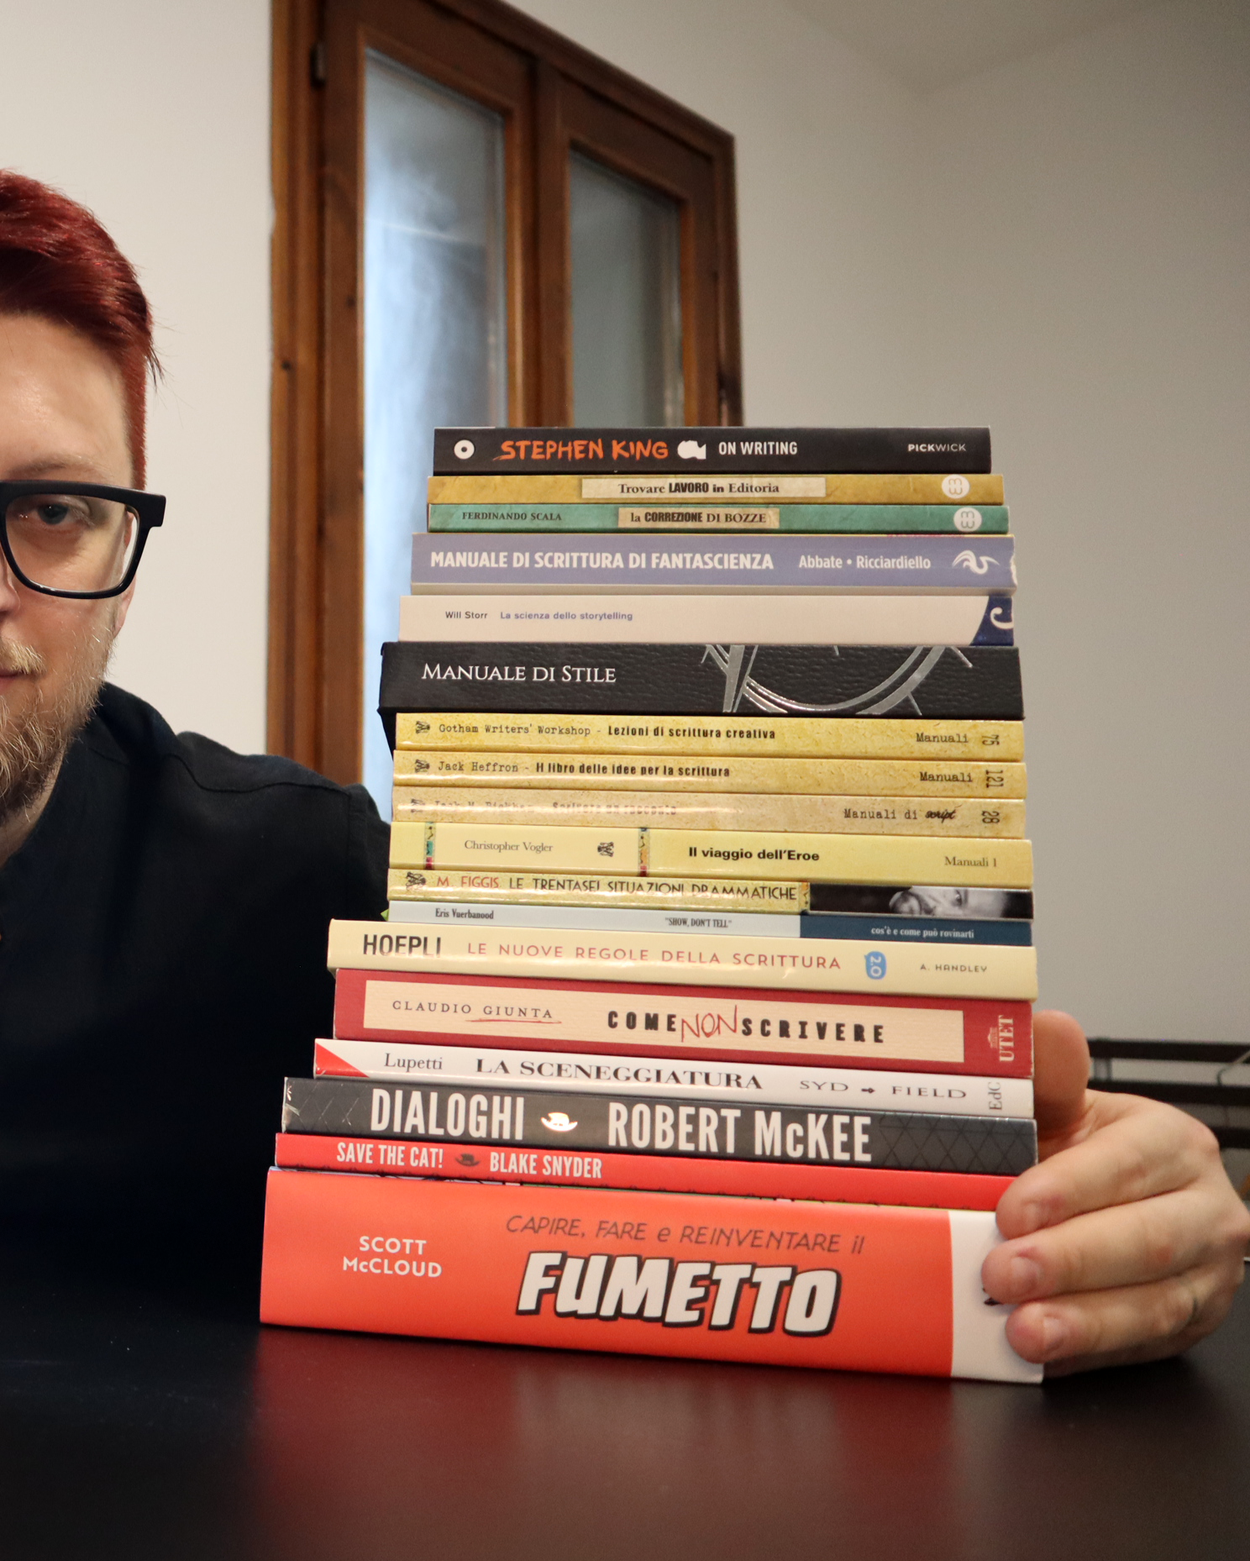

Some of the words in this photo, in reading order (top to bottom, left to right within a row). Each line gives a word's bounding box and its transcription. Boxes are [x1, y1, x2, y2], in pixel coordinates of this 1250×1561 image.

[493, 439, 603, 461] STEPHEN
[612, 439, 669, 460] KING
[719, 442, 738, 455] ON
[740, 442, 798, 455] WRITING
[908, 444, 966, 452] PICKWICK
[618, 484, 665, 494] Trovare
[669, 483, 709, 493] LAVORO
[712, 484, 724, 492] in
[728, 482, 780, 493] Editoria
[462, 512, 527, 520] FERDINANDO
[531, 513, 562, 521] SCALA
[631, 513, 640, 522] la
[644, 512, 702, 522] CORREZIONE
[706, 514, 721, 522] DI
[724, 512, 766, 522] BOZZE
[431, 552, 507, 567] MANUALE
[513, 552, 529, 567] DI
[534, 552, 623, 568] SCRITTURA
[629, 553, 646, 569] DI
[651, 553, 774, 570] FANTASCIENZA
[799, 555, 842, 568] Abbate
[856, 556, 931, 569] Ricciardiello
[445, 611, 461, 619] Will
[465, 611, 487, 619] Storr
[553, 612, 576, 620] dello
[580, 612, 633, 621] storytelling
[439, 724, 478, 732] Gotham
[485, 724, 532, 733] Writers'
[538, 725, 590, 736] Workshop
[608, 725, 649, 736] Lezioni
[653, 726, 664, 736] di
[669, 727, 721, 738] scrittura
[726, 728, 776, 739] creativa
[916, 732, 969, 743] Manuali
[982, 734, 999, 746] 75
[438, 761, 464, 771] Jack
[472, 762, 518, 772] Heffron
[548, 762, 574, 773] libro
[579, 763, 608, 774] delle
[612, 764, 636, 775] idee
[641, 766, 659, 776] per
[664, 765, 674, 775] la
[678, 766, 730, 777] scrittura
[920, 772, 973, 782] Manuali
[986, 770, 1004, 788] 121
[844, 808, 896, 819] Manuali
[905, 810, 918, 819] di
[925, 809, 956, 823] script
[982, 810, 999, 824] 28
[465, 840, 519, 852] Christopher
[523, 842, 553, 854] Vogler
[689, 847, 697, 857] Il
[702, 848, 752, 861] viaggio
[757, 849, 820, 861] dell'Eroe
[945, 856, 988, 867] Manuali
[510, 878, 523, 889] LE
[533, 878, 600, 891] TRENTASEI
[435, 908, 449, 918] Eris
[691, 918, 711, 927] DON'T
[923, 928, 938, 938] può
[940, 929, 974, 938] rovinarti
[363, 934, 441, 958] HOEPLI
[468, 943, 487, 954] LE
[500, 944, 563, 957] NUOVE
[576, 947, 649, 962] REGOLE
[662, 950, 720, 964] DELLA
[732, 953, 841, 970] SCRITTURA
[869, 955, 882, 977] 2.0
[935, 964, 988, 972] HANDLEY
[392, 1000, 472, 1014] CLAUDIO
[483, 1006, 553, 1019] GIUNTA
[608, 1010, 677, 1032] COME
[680, 1004, 738, 1042] NON
[741, 1018, 884, 1043] SCRIVERE
[998, 1015, 1015, 1062] UTET
[384, 1053, 443, 1072] Lupetti
[476, 1058, 510, 1074] LA
[519, 1060, 763, 1090] SCENEGGIATURA
[800, 1081, 848, 1092] SYD
[892, 1086, 967, 1099] FIELD
[988, 1081, 1002, 1111] EdC
[370, 1088, 524, 1140] DIALOGHI
[608, 1102, 741, 1154] ROBERT
[754, 1110, 872, 1162] McKEE
[337, 1142, 373, 1164] SAVE
[378, 1144, 405, 1166] THE
[410, 1147, 444, 1169] CAT!
[490, 1152, 537, 1174] BLAKE
[542, 1155, 602, 1179] SNYDER
[506, 1215, 585, 1239] CAPIRE,
[596, 1220, 647, 1241] FARE
[657, 1229, 671, 1243] e
[679, 1225, 841, 1253] REINVENTARE
[851, 1234, 864, 1255] il
[359, 1236, 427, 1255] SCOTT
[343, 1256, 442, 1278] McCLOUD
[515, 1251, 842, 1337] FUMETTO
